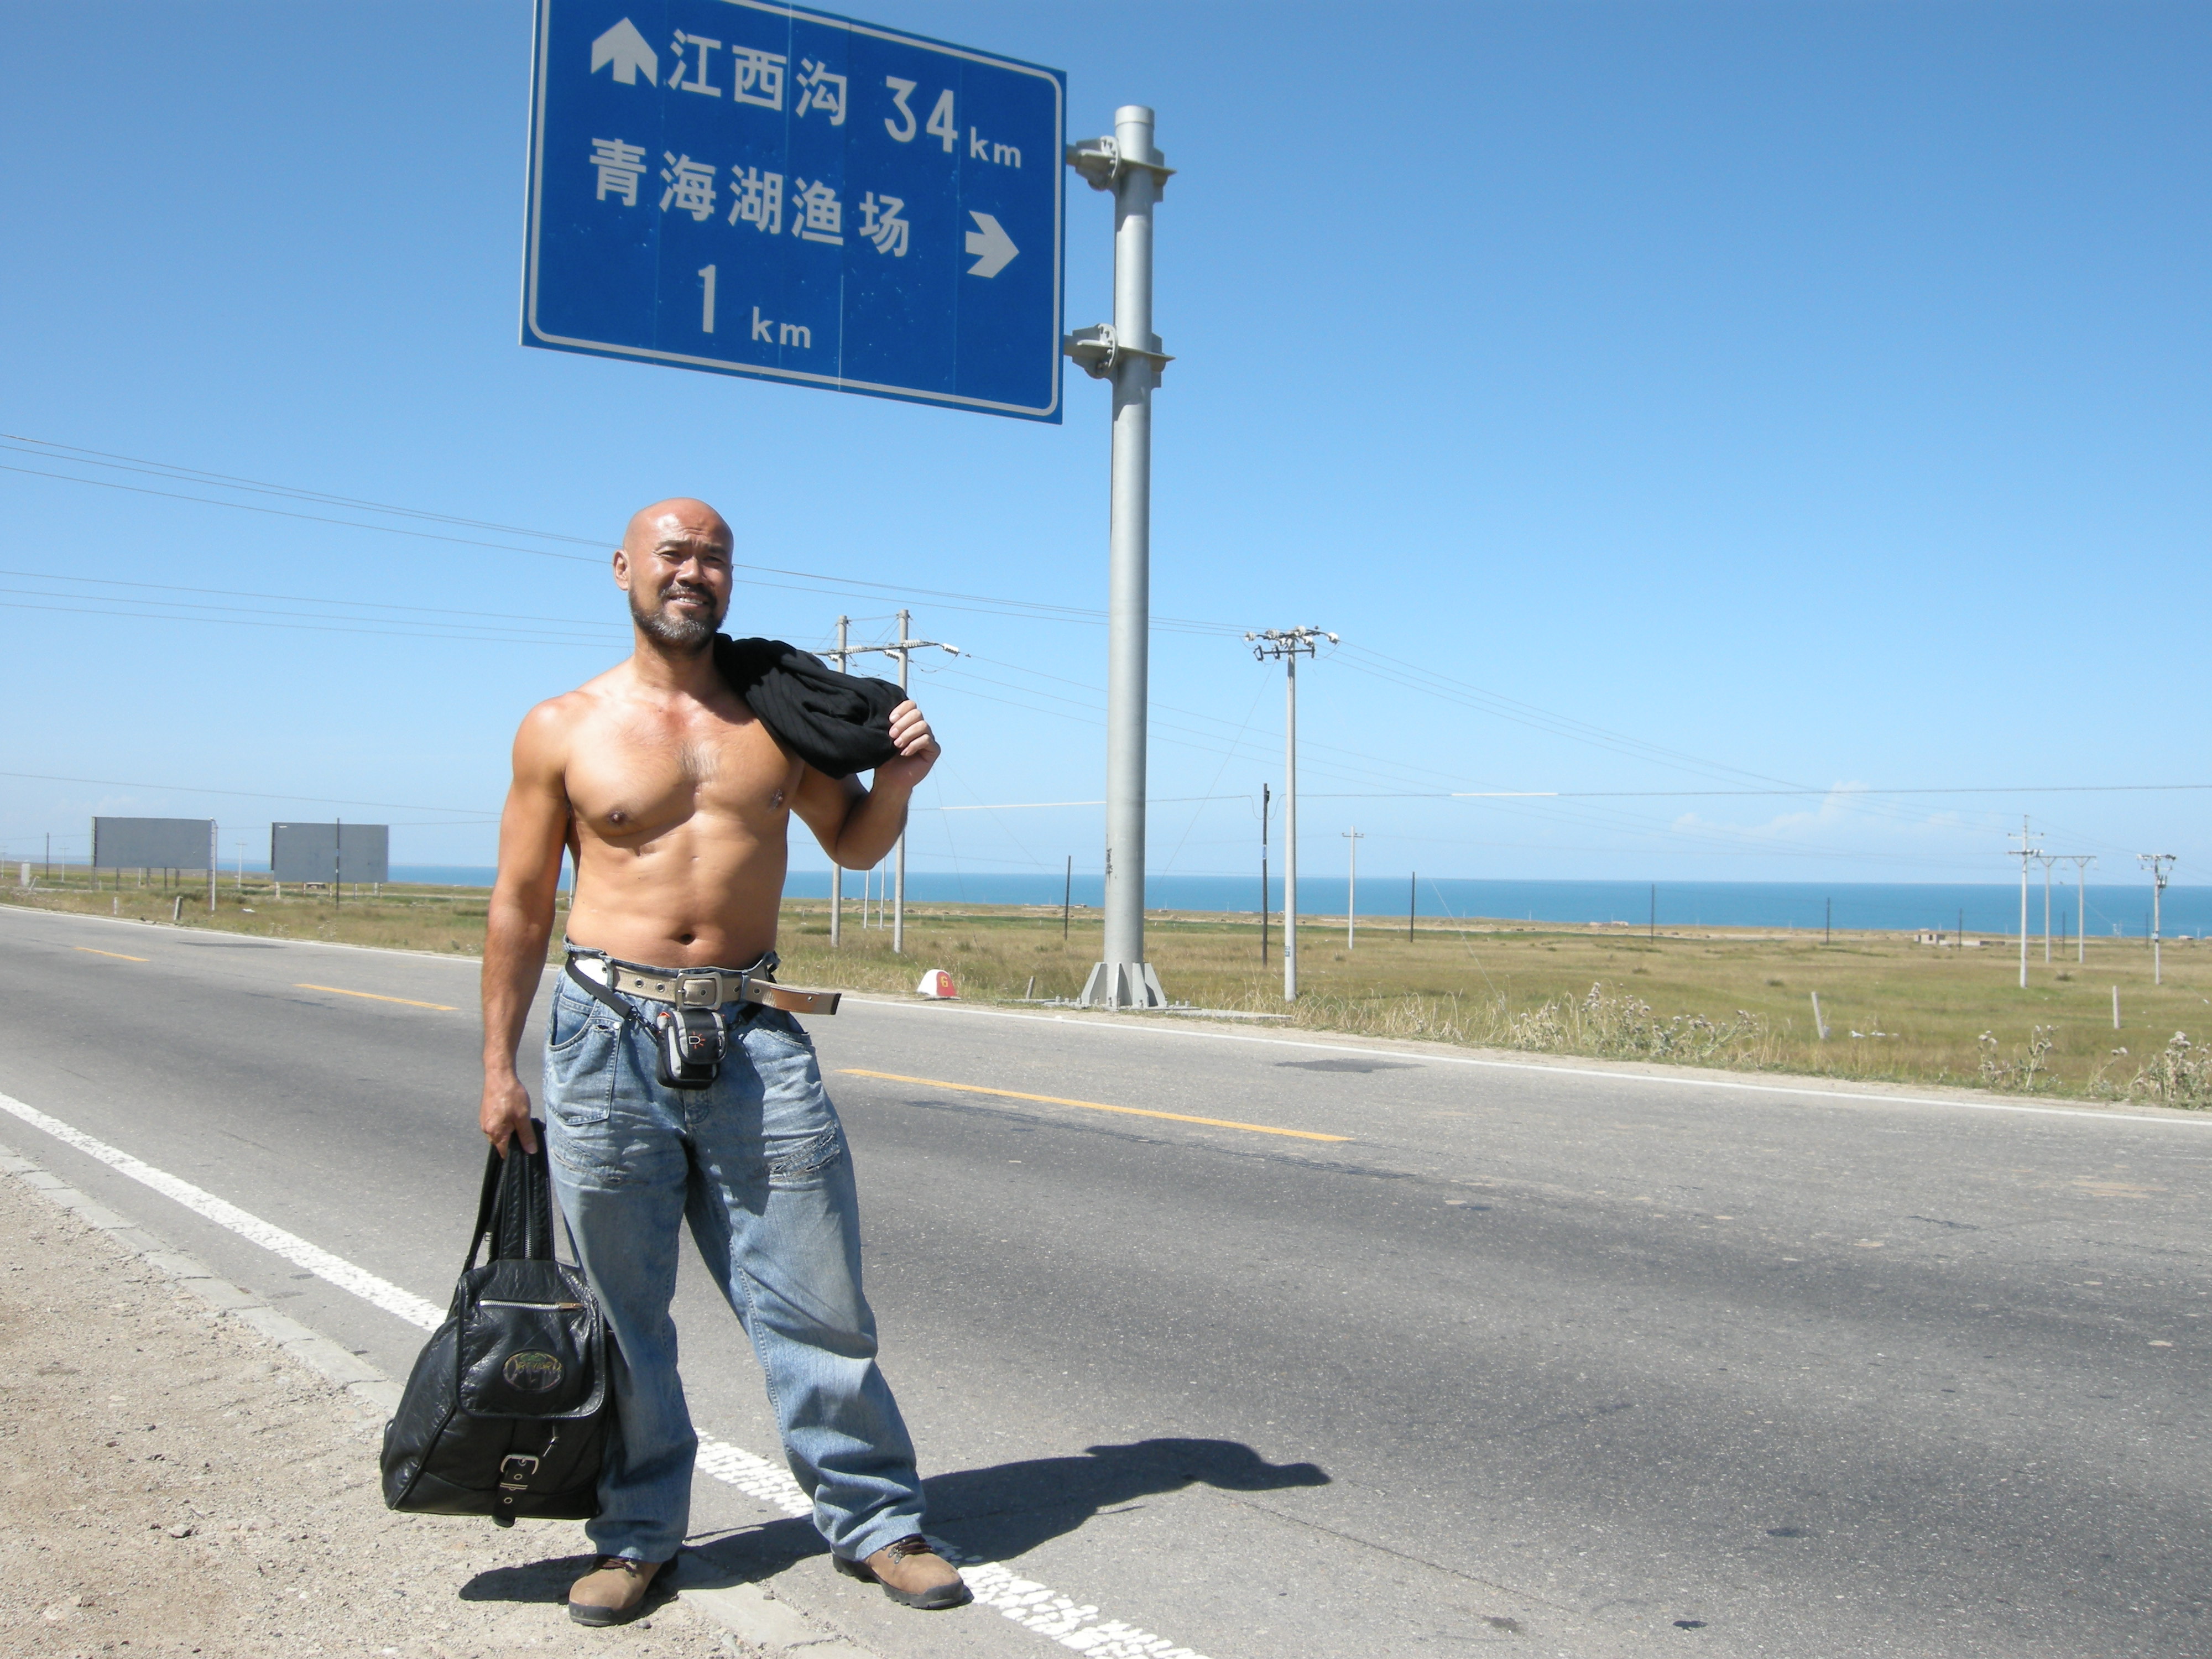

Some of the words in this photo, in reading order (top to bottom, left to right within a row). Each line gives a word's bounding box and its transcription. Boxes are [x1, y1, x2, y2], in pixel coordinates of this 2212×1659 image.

[669, 29, 848, 126] 江西沟
[885, 76, 958, 153] 34
[971, 127, 1021, 169] km
[589, 138, 910, 258] 青海湖渔场
[697, 264, 716, 333] 1
[752, 306, 811, 349] km
